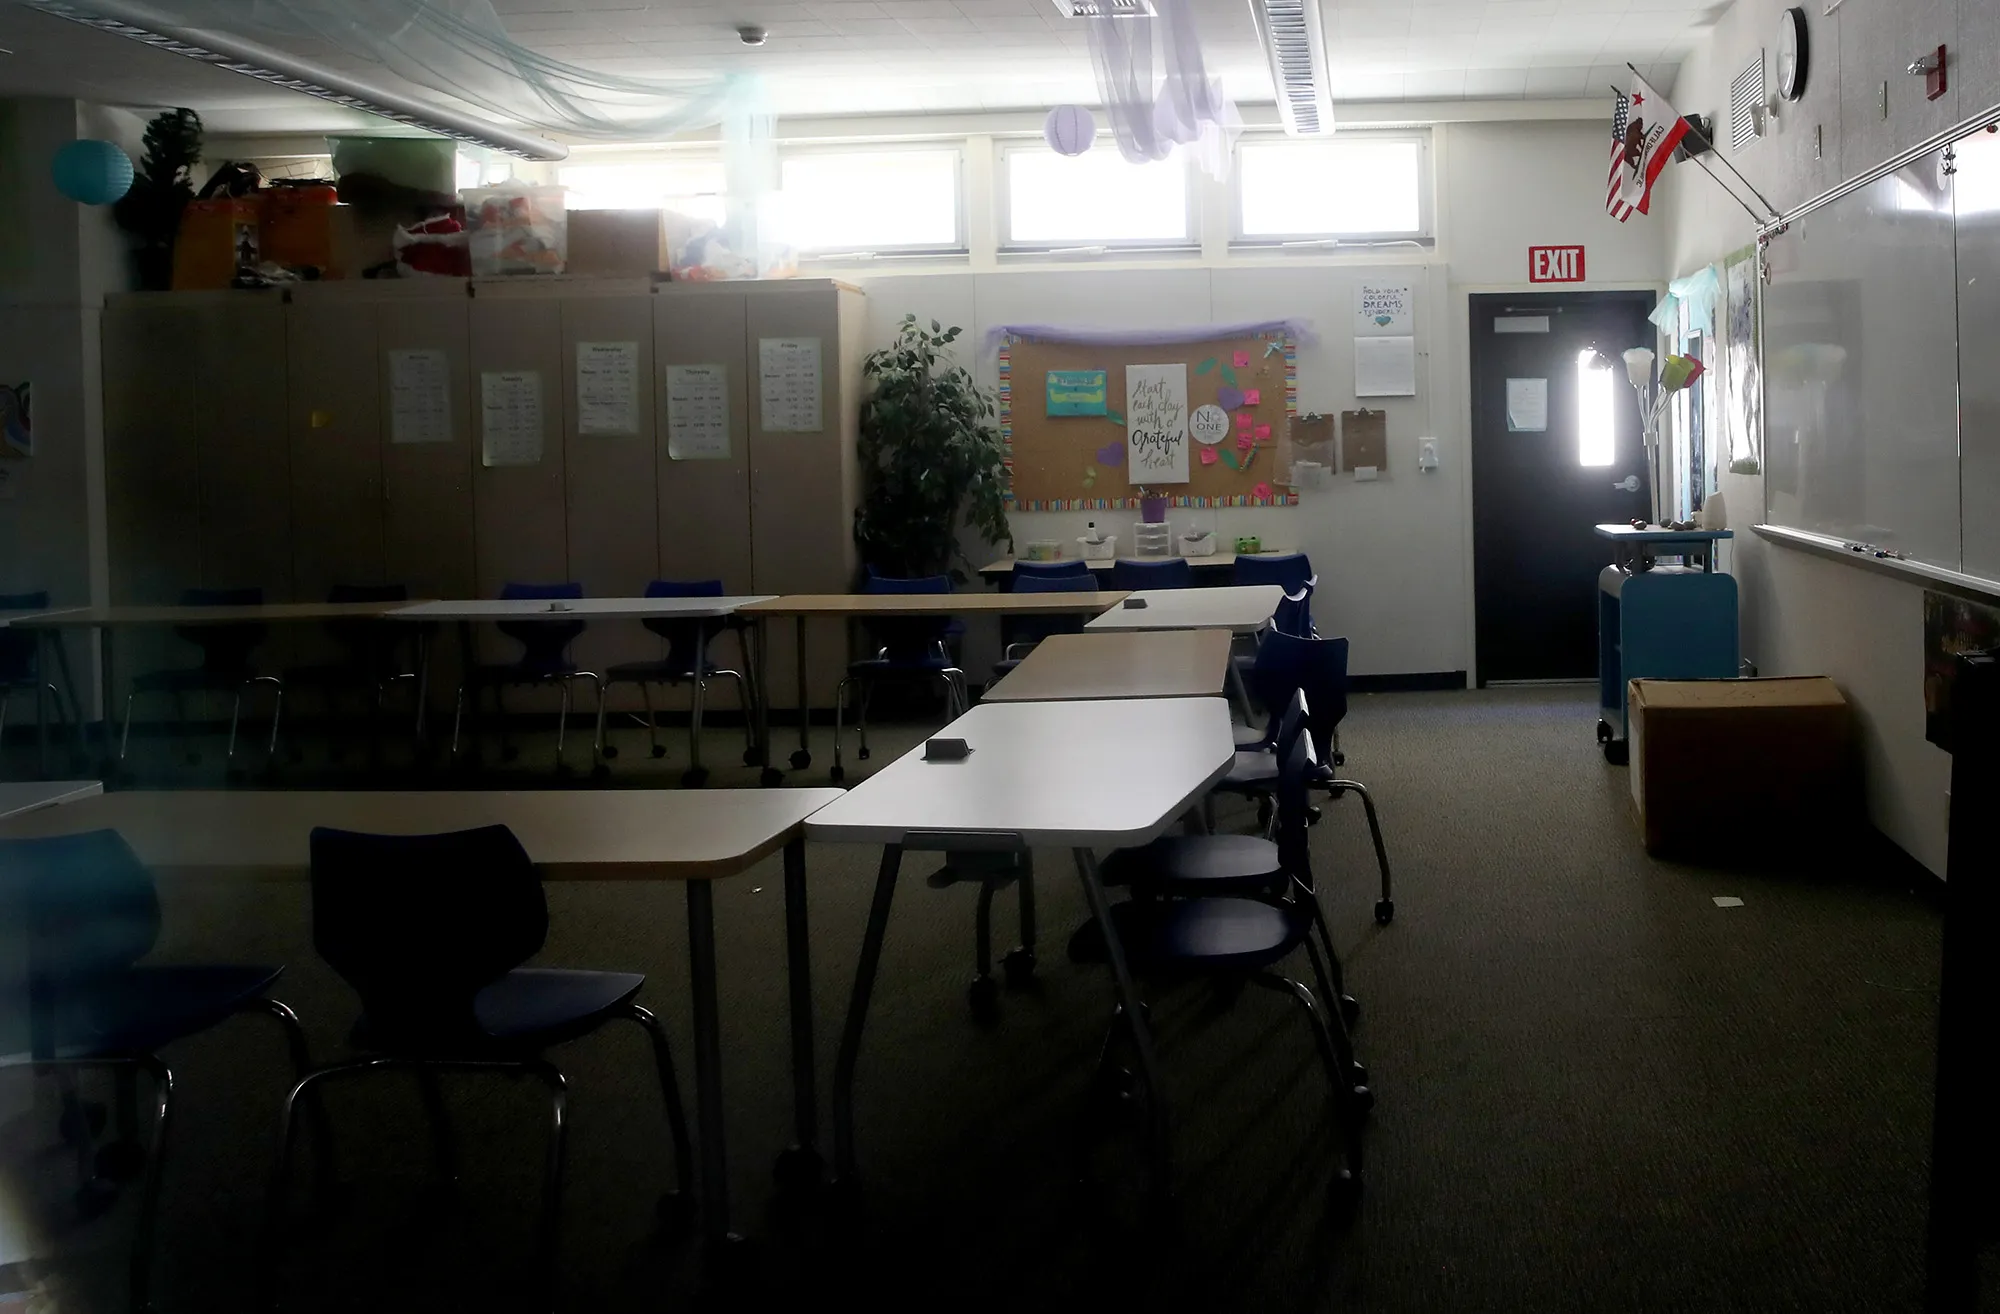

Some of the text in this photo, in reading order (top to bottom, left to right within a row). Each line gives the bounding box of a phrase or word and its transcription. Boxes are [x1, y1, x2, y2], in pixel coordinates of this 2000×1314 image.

[1534, 249, 1580, 280] EXIT
[1363, 300, 1403, 309] DREAMS
[1132, 389, 1183, 420] each day
[1135, 408, 1174, 430] with a
[1196, 422, 1221, 431] ONE
[1141, 448, 1176, 470] heart
